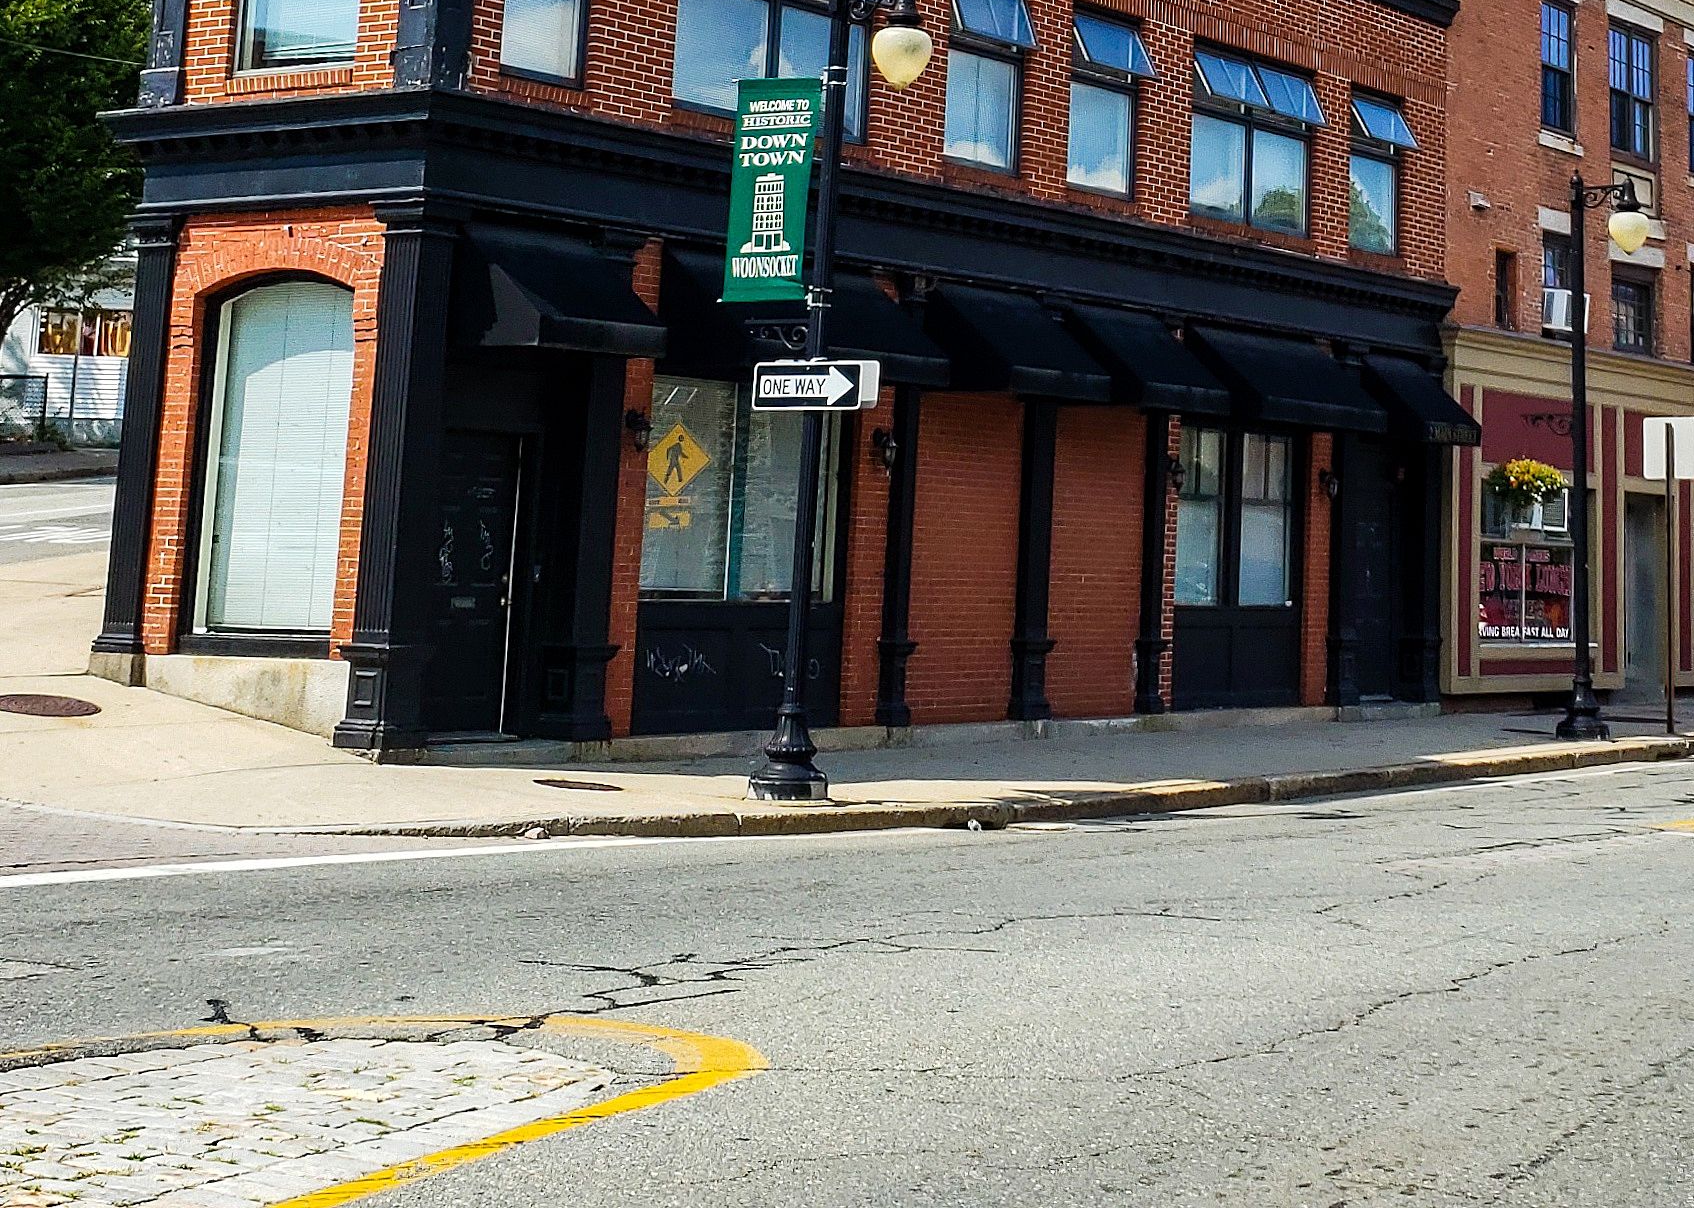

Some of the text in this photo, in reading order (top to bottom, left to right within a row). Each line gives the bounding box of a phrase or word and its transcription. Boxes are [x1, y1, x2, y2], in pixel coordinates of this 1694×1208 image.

[749, 99, 810, 113] WELCOME TO
[743, 114, 811, 127] HISTORIC
[740, 132, 809, 150] DOWN
[738, 150, 806, 168] TOWN
[732, 254, 799, 279] WOONSOCKET
[763, 377, 827, 396] ONE WAY
[1501, 625, 1540, 638] BREAFAST
[1541, 626, 1554, 638] ALL
[1555, 626, 1570, 638] DAY
